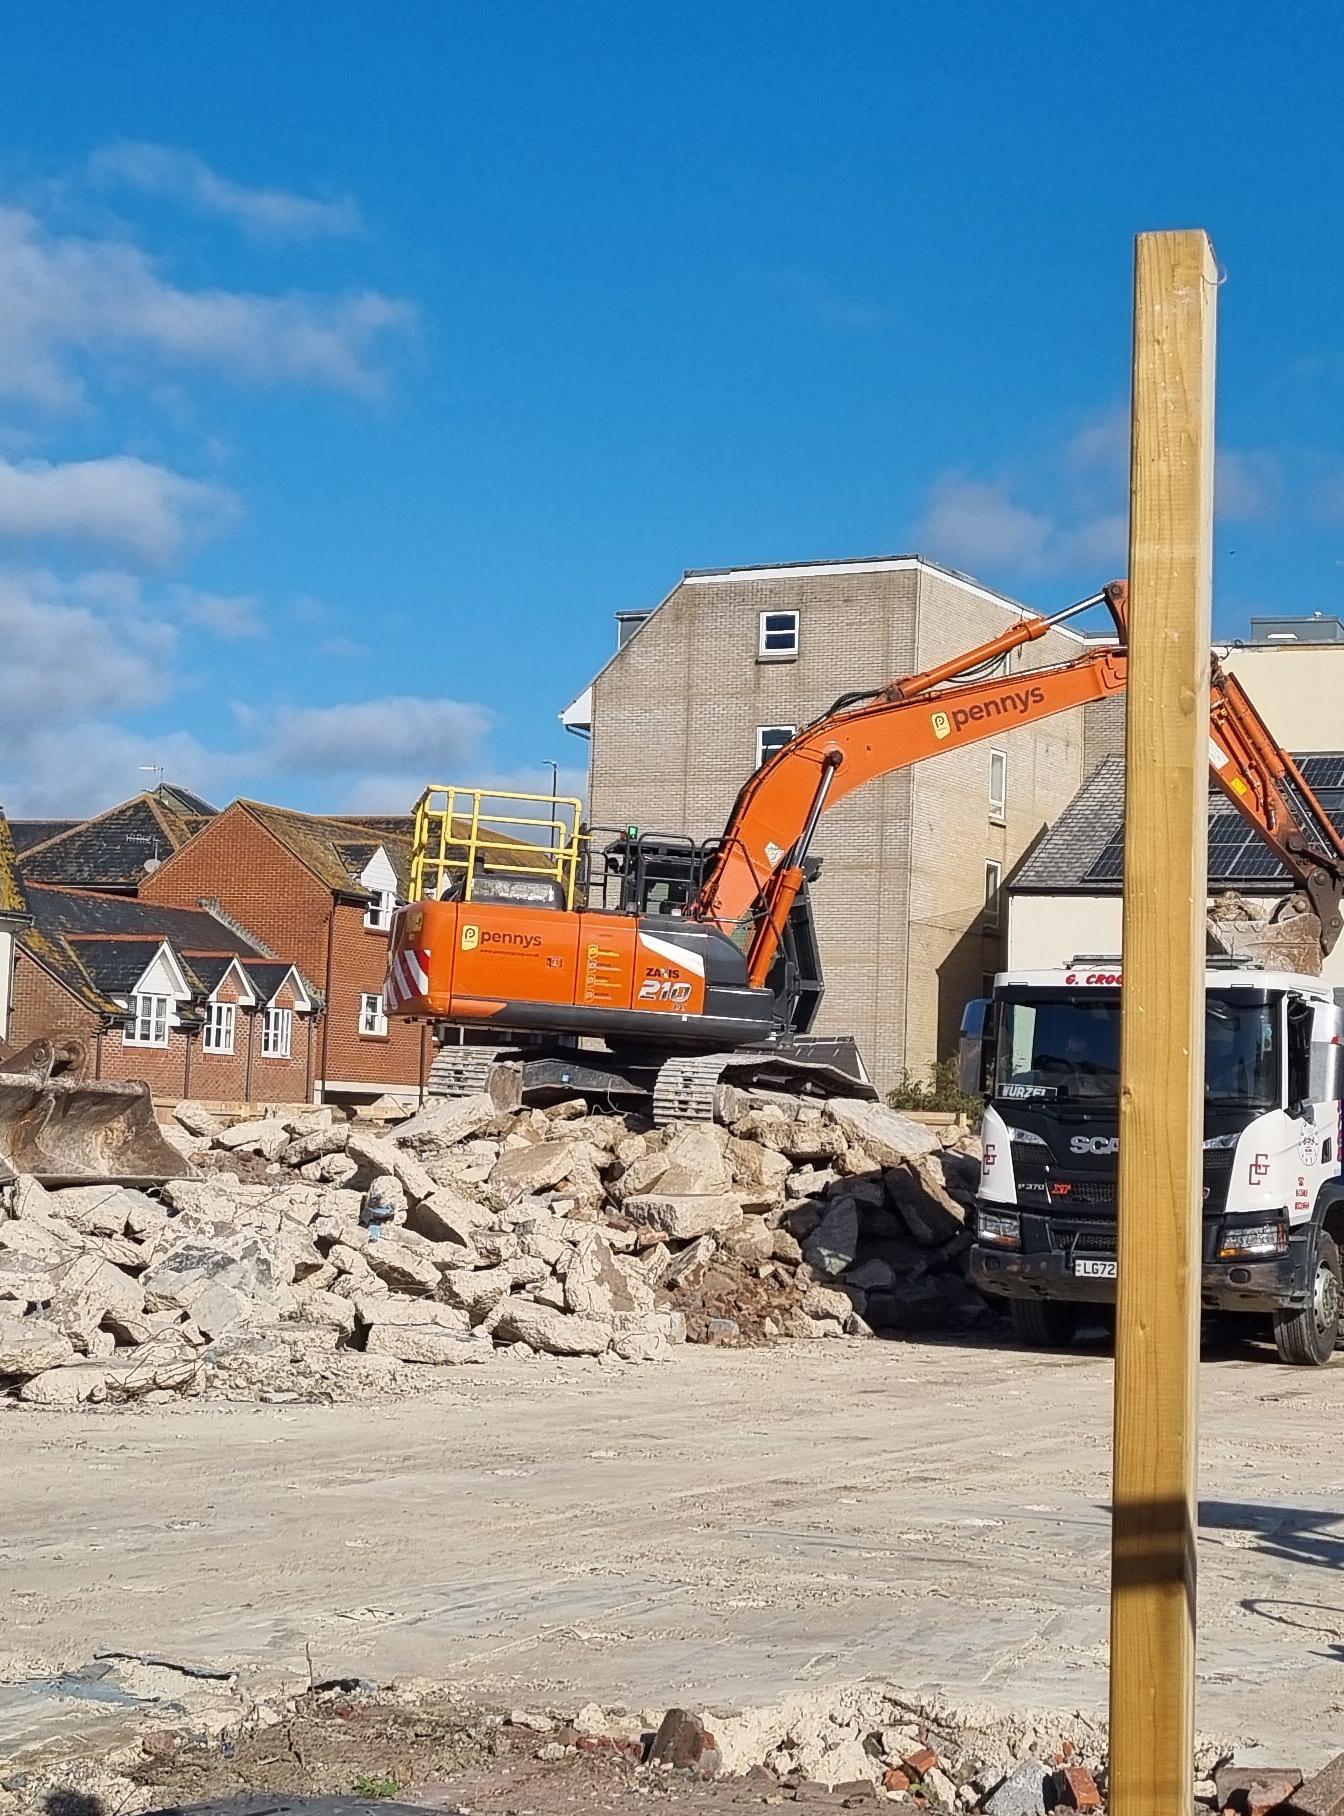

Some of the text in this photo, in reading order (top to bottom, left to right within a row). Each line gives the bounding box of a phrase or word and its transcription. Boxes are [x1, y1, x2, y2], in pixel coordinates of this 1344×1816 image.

[951, 686, 1045, 732] pennys
[480, 931, 542, 949] pennys
[1065, 973, 1123, 985] G. CROO
[638, 979, 692, 1003] 210
[1069, 1135, 1120, 1155] SCA
[1083, 1262, 1116, 1276] LG72
